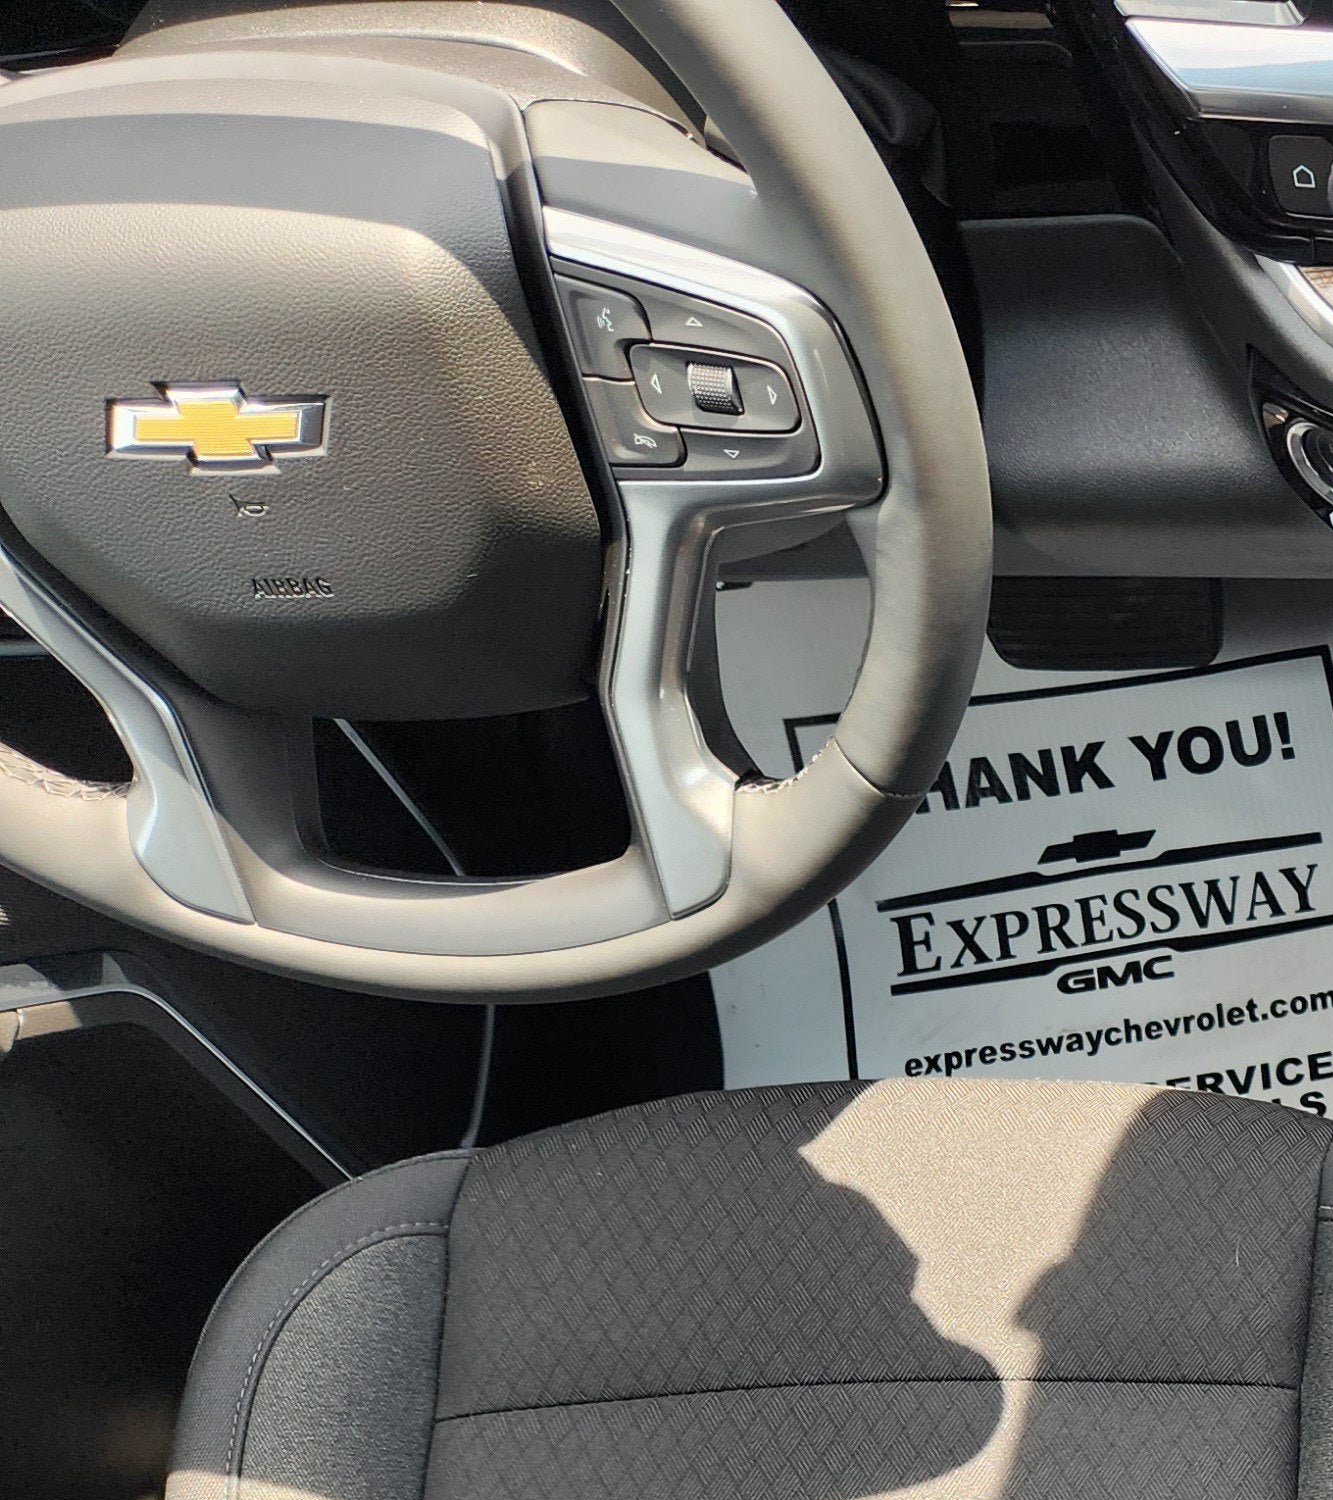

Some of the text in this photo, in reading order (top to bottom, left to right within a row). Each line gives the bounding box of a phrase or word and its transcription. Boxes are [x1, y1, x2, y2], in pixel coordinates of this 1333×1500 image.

[251, 577, 335, 599] AIRBAG
[915, 711, 1296, 815] HANK YOU!
[890, 864, 1319, 978] EXPRESSWAY
[1056, 955, 1176, 995] GMC
